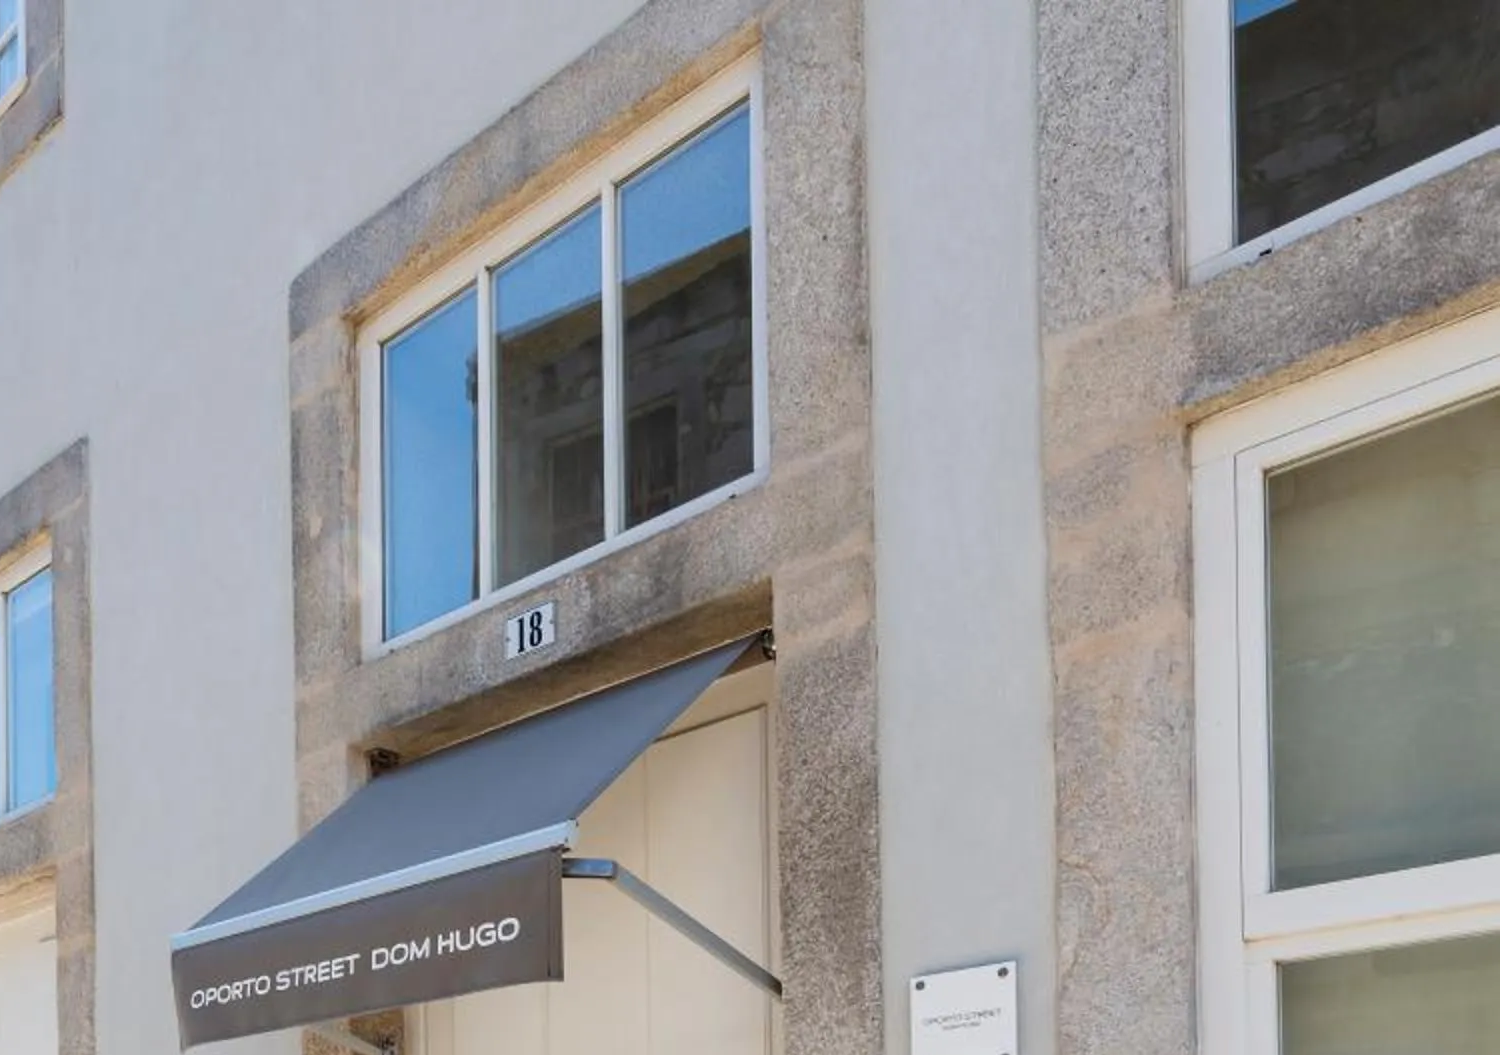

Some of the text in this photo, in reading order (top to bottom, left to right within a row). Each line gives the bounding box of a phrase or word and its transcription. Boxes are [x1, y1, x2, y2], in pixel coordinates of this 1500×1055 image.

[517, 610, 543, 653] 18
[190, 917, 521, 1010] OPORTO STREET DOM HUGO
